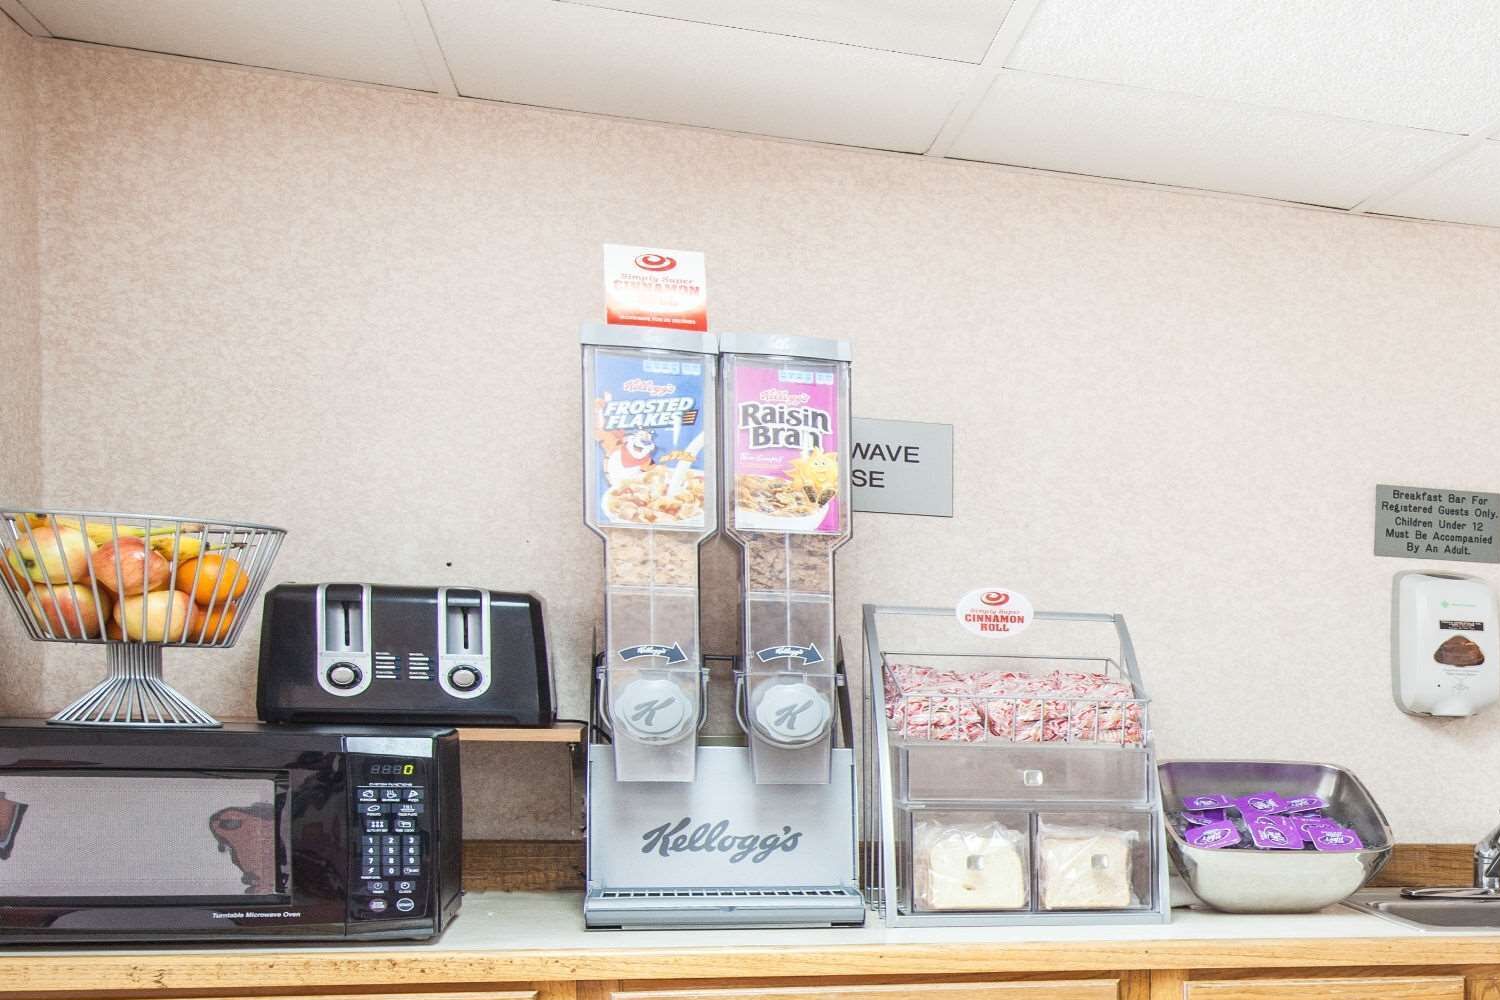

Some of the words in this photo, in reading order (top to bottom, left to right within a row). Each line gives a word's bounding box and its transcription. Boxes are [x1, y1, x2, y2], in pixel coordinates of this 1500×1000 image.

[604, 397, 695, 416] FROSTED
[741, 403, 830, 433] Raisin
[1392, 489, 1442, 503] Breakfast
[1448, 493, 1466, 505] Bar
[1471, 495, 1489, 506] For
[1381, 501, 1433, 515] Registered
[1438, 506, 1469, 517] Guests
[1474, 508, 1499, 520] Only.
[1394, 516, 1433, 529] Children
[1438, 519, 1468, 531] Under
[1472, 521, 1484, 532] 12
[1385, 528, 1410, 540] Must
[1415, 530, 1428, 541] Be
[1432, 532, 1493, 545] Accompanied
[1406, 543, 1420, 554] By
[1425, 544, 1438, 553] An
[964, 613, 1025, 624] CINNAMON
[980, 623, 1010, 632] ROLL
[631, 696, 676, 726] K
[774, 699, 814, 730] K
[403, 764, 414, 775] 0
[641, 816, 803, 864] Kellogg's
